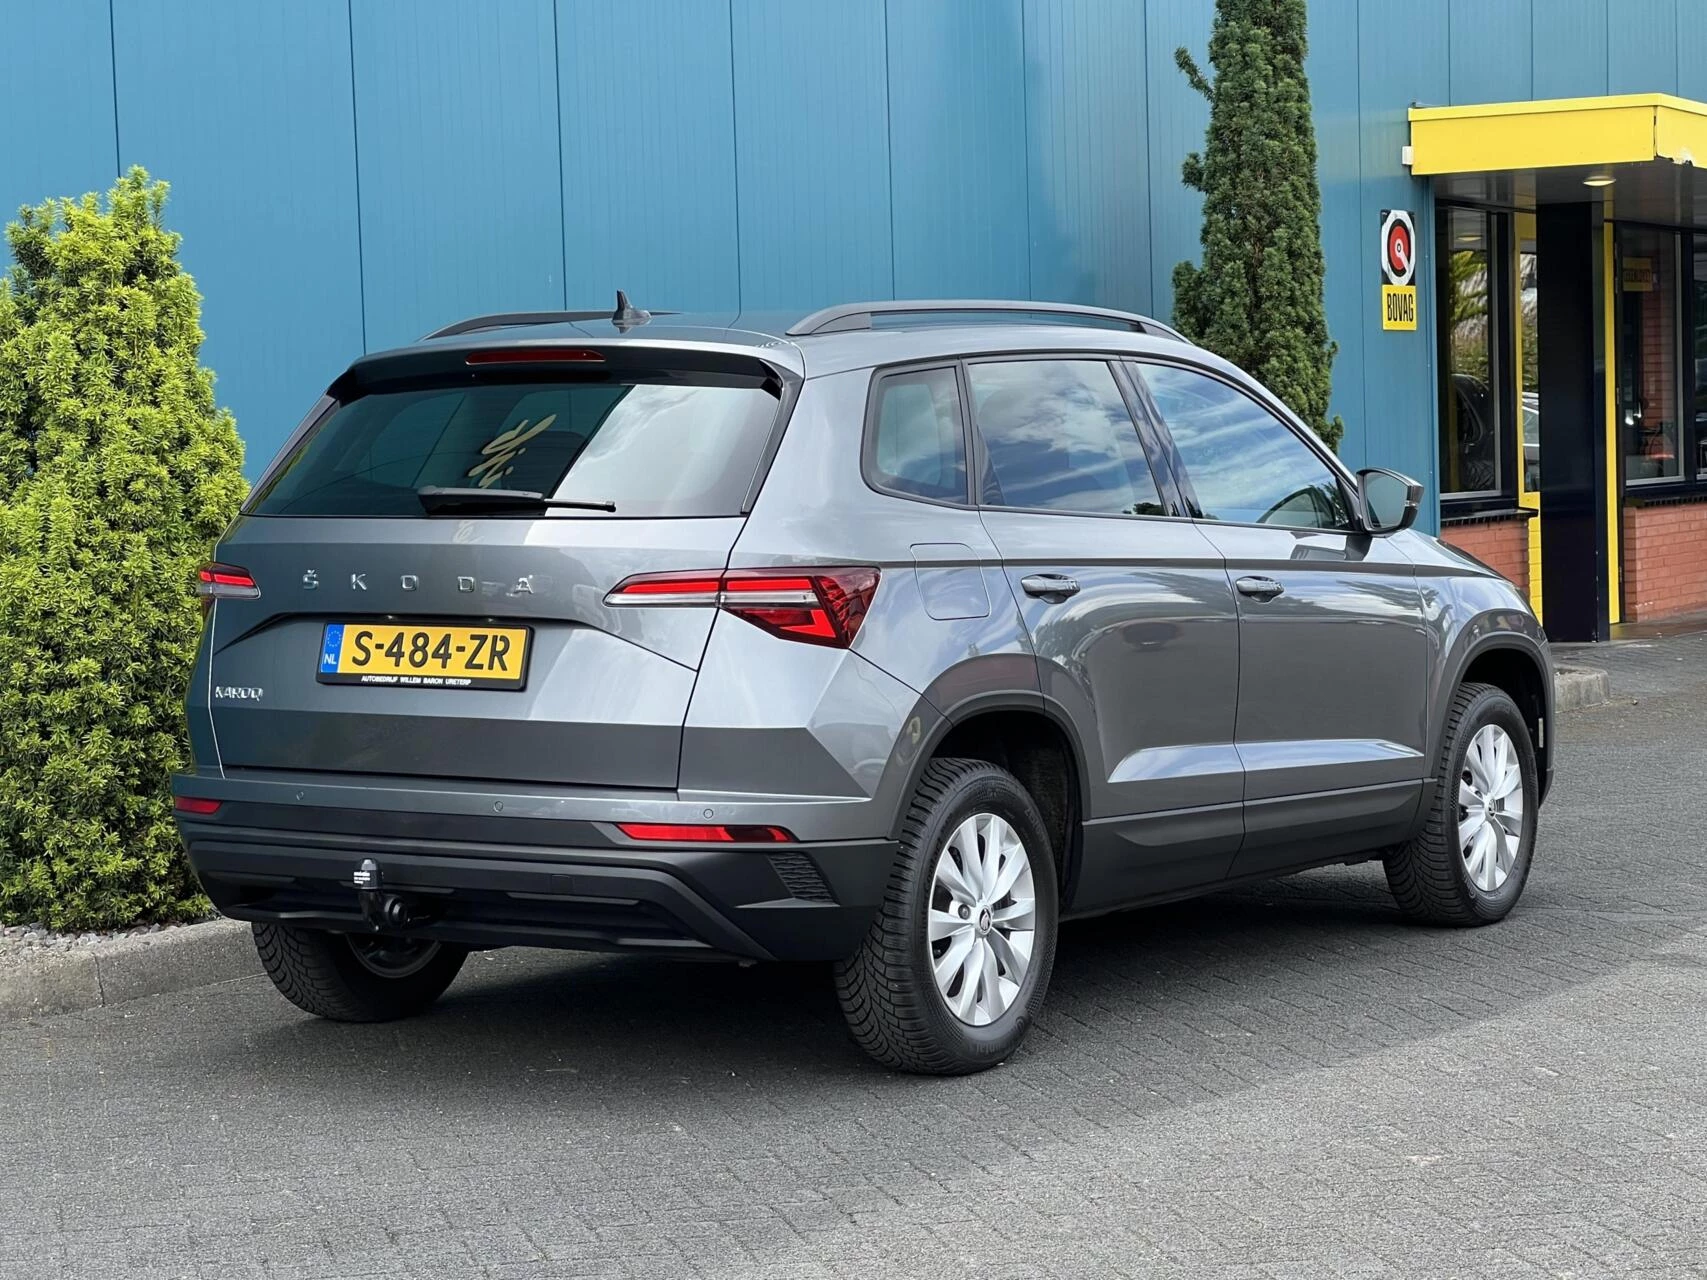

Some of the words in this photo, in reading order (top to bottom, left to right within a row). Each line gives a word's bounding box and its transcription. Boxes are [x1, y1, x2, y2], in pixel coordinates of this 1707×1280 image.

[1386, 293, 1414, 322] BOVAG
[323, 653, 338, 665] NL
[351, 630, 511, 672] S-484-ZR
